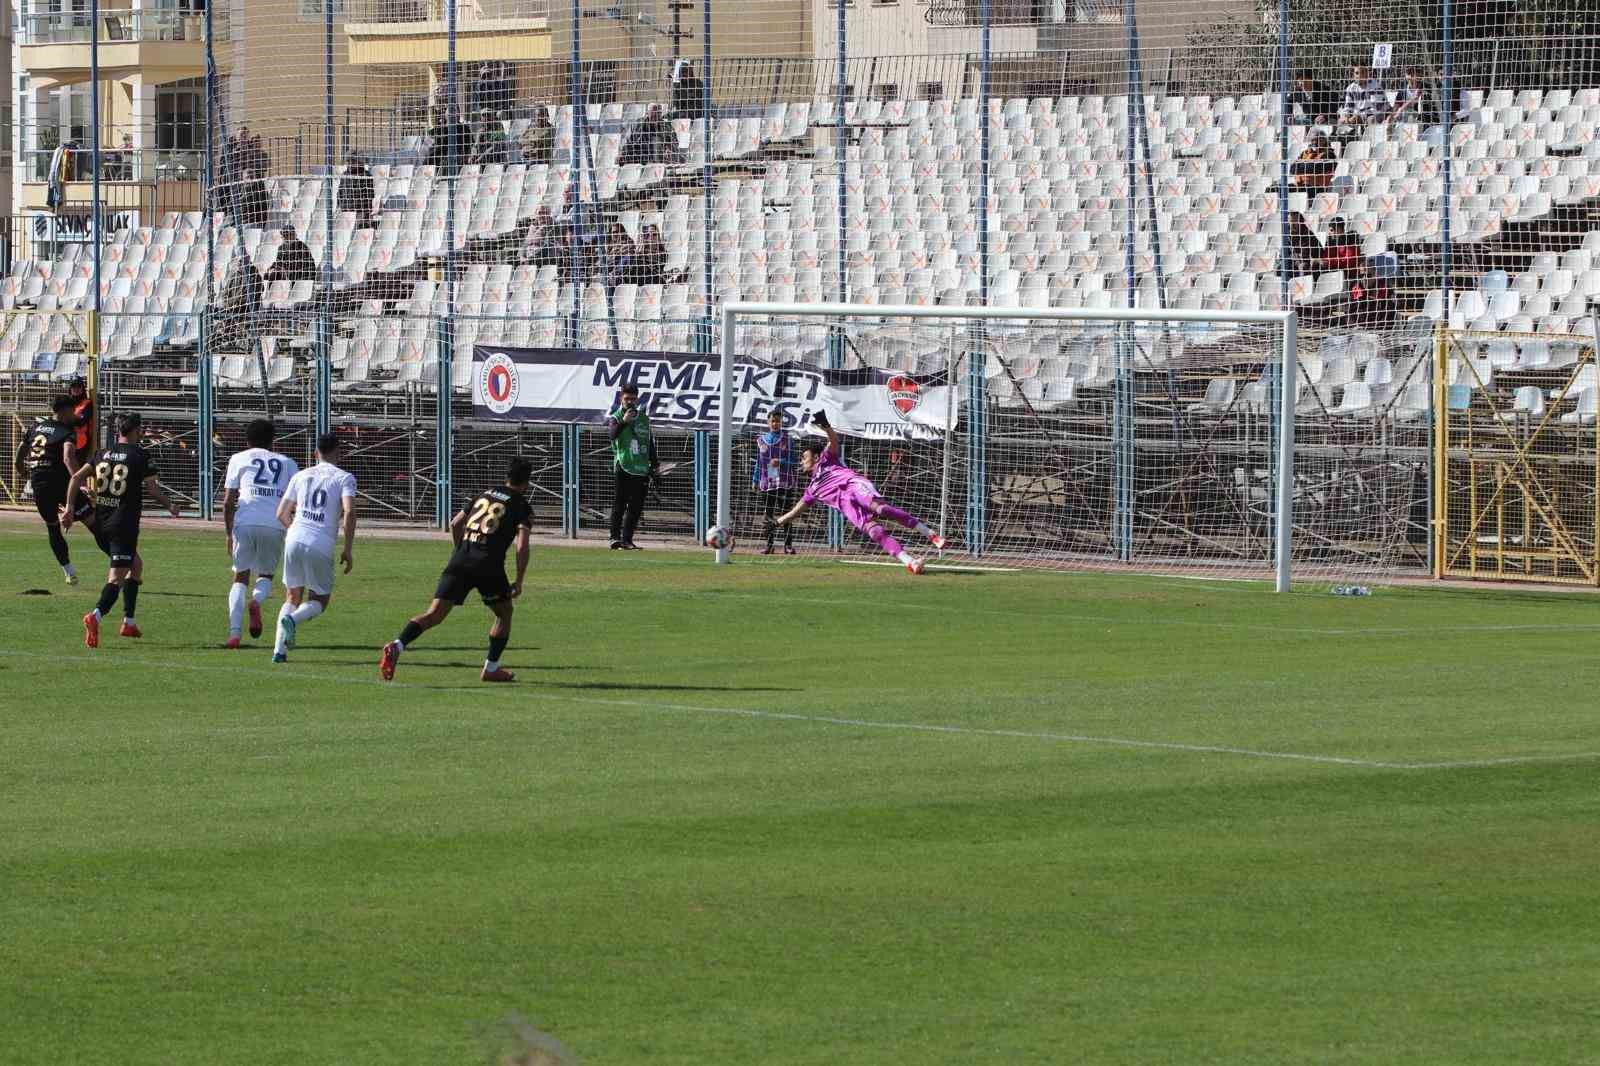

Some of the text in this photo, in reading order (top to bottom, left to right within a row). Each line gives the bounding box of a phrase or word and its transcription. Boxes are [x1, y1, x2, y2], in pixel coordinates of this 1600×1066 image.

[95, 461, 129, 496] 88
[251, 458, 282, 484] 29
[466, 497, 506, 535] 28
